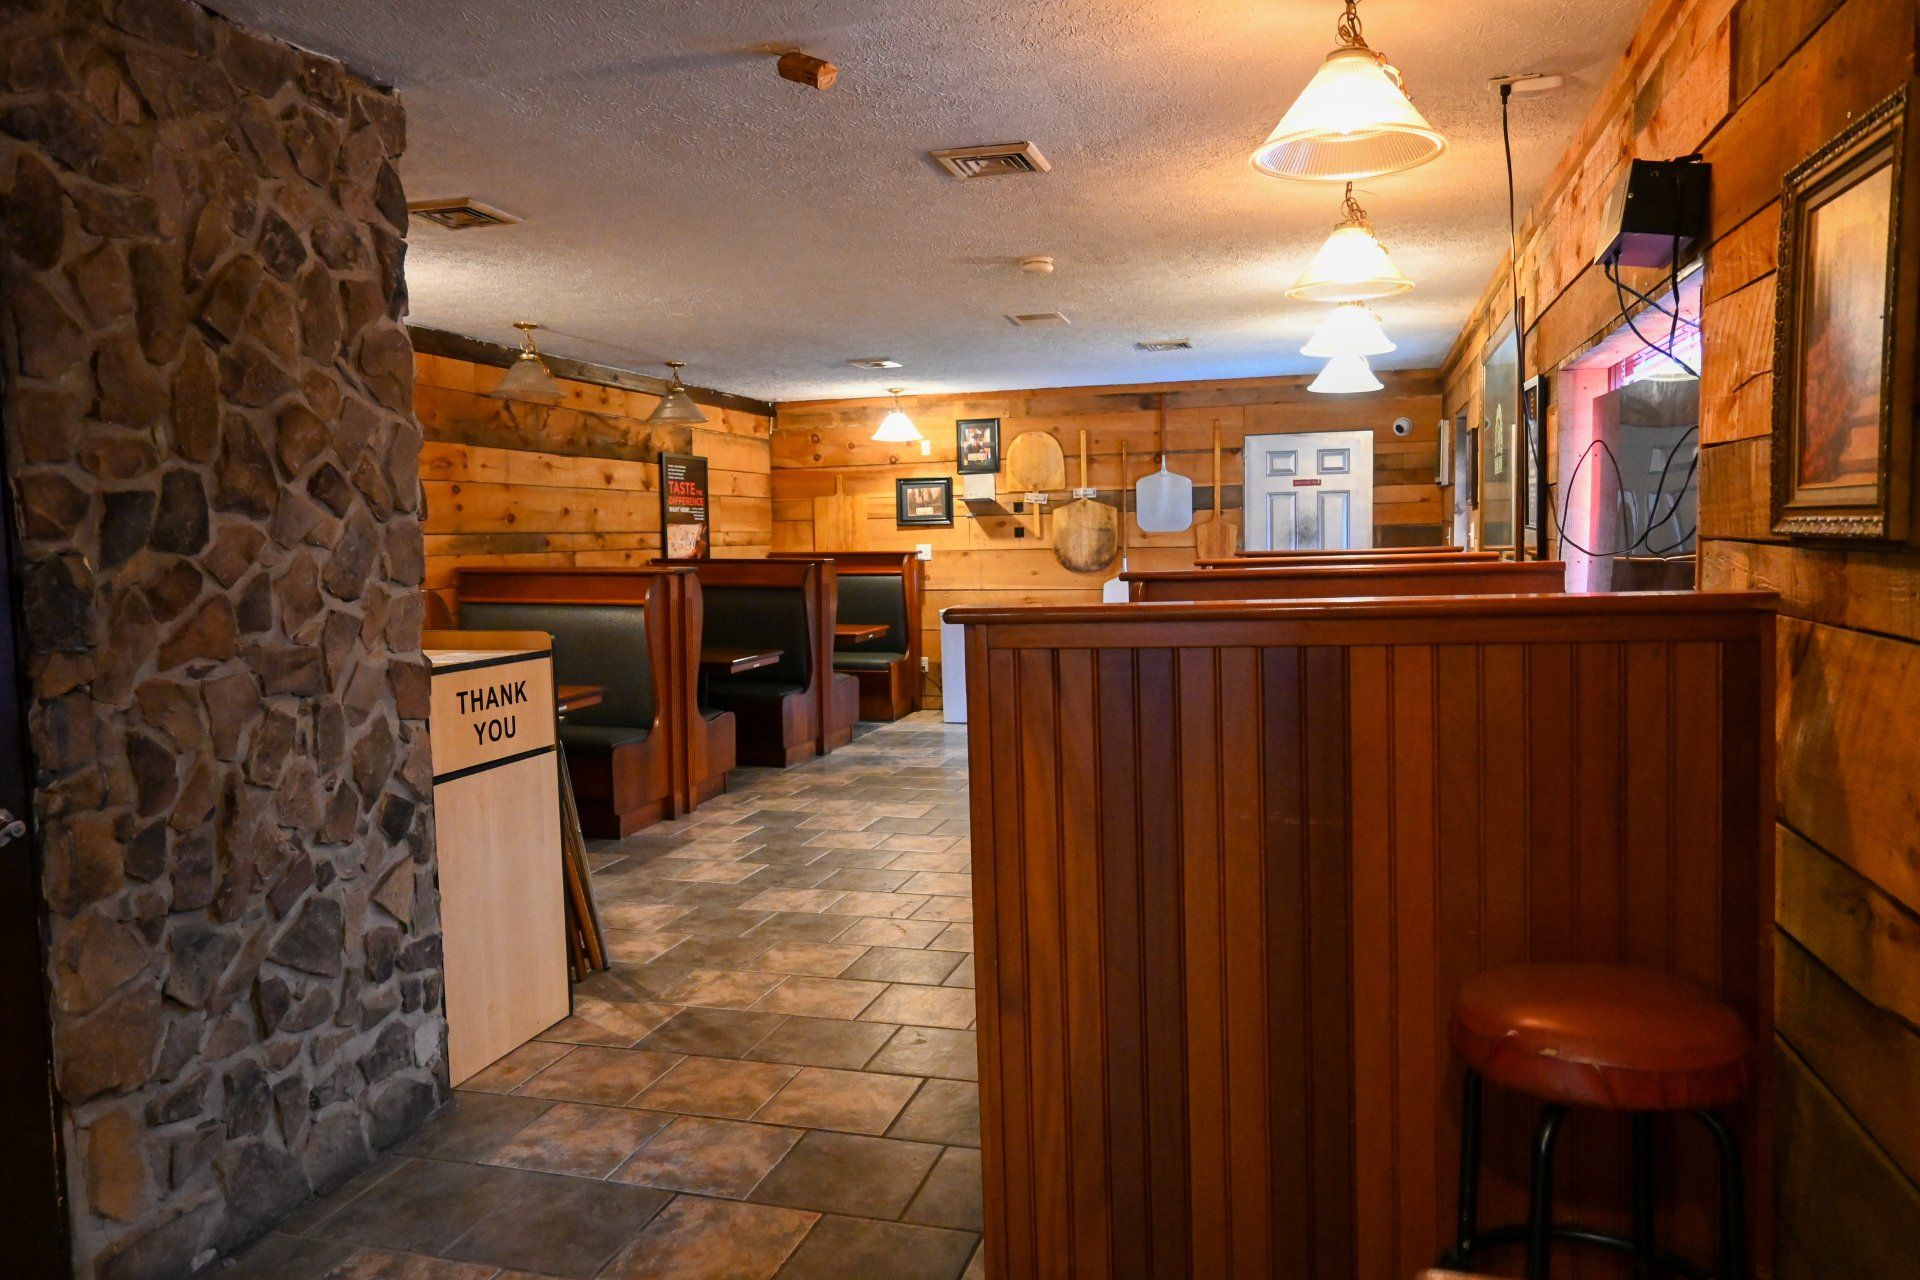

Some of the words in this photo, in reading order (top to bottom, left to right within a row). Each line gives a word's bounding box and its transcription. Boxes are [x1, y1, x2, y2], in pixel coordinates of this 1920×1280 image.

[668, 480, 696, 496] TASTE
[668, 496, 704, 506] DIFFERENCE
[456, 680, 528, 715] THANK
[473, 715, 516, 745] YOU
